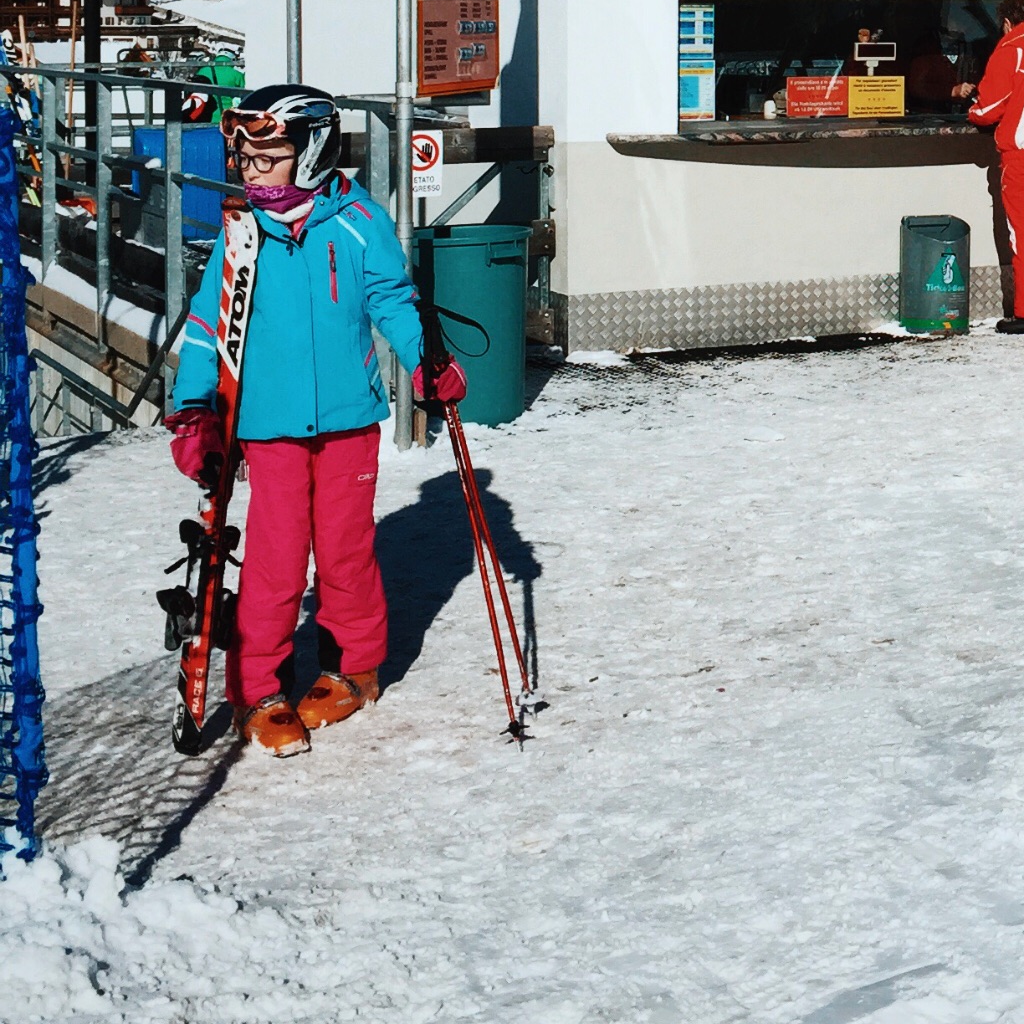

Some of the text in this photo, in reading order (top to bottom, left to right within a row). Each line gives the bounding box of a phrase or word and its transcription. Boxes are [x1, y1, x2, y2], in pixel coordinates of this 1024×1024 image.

[413, 176, 435, 184] ETATO
[412, 184, 441, 193] GRESSO
[226, 241, 253, 368] ATOM
